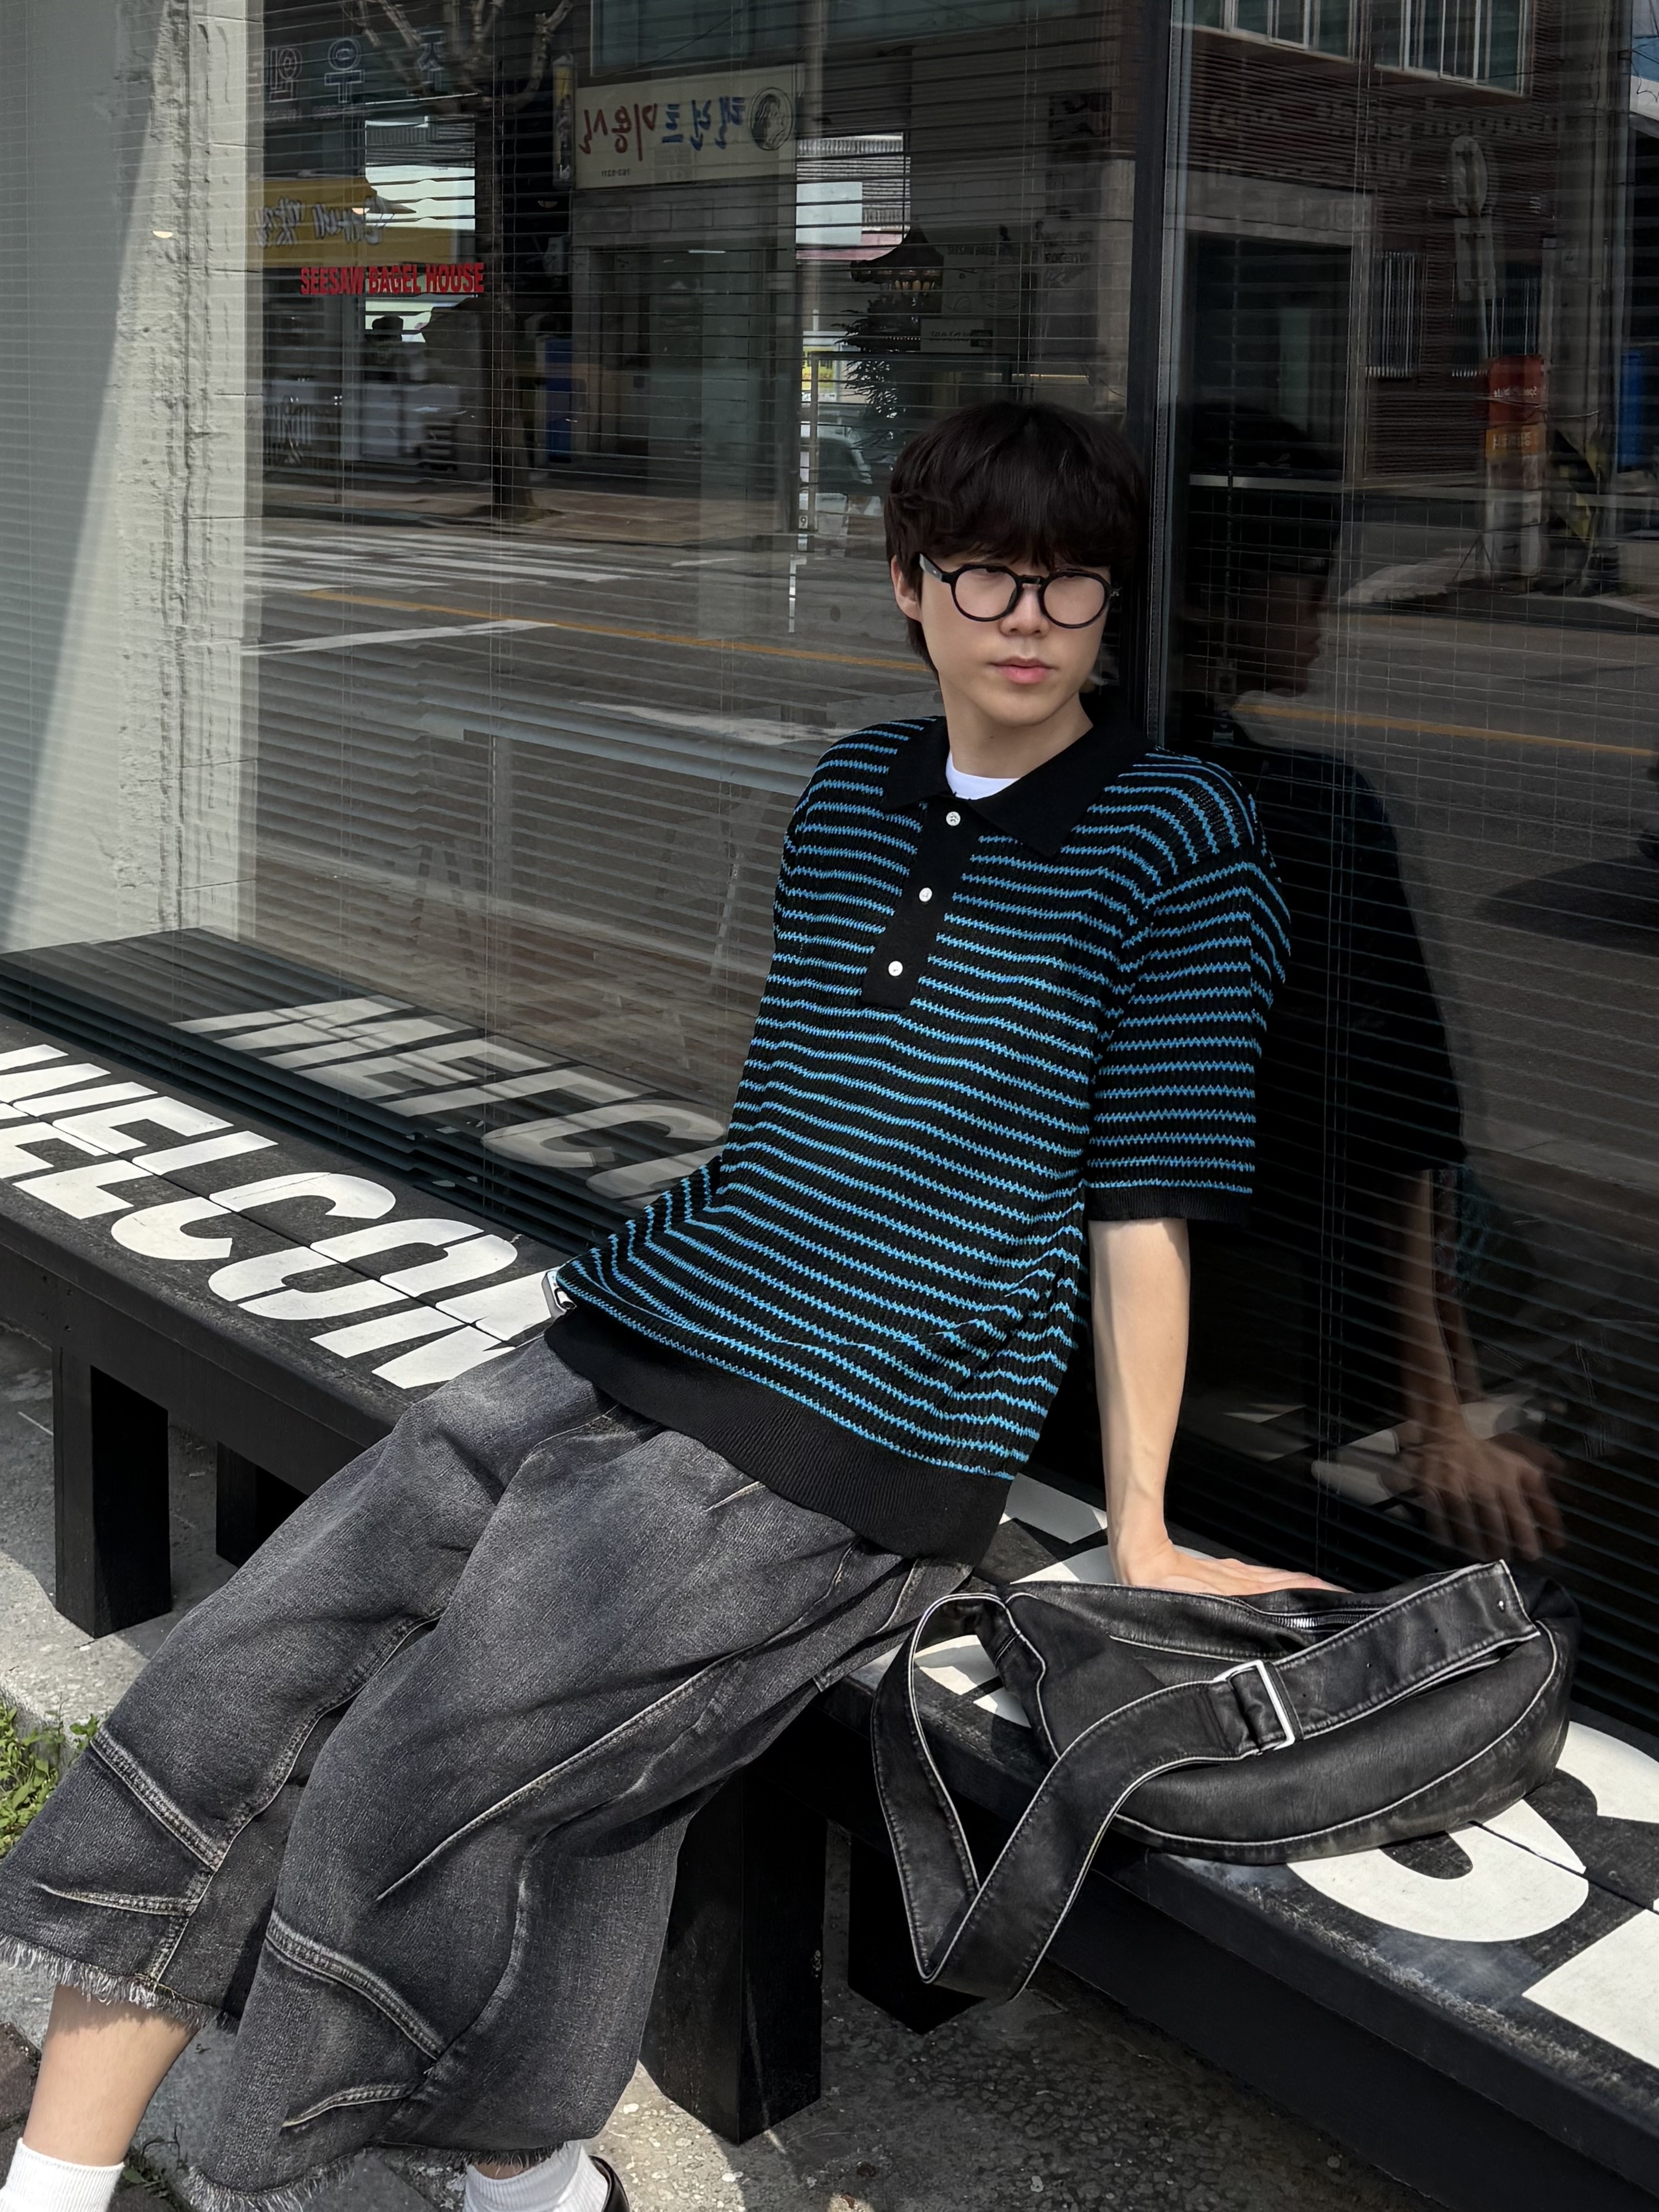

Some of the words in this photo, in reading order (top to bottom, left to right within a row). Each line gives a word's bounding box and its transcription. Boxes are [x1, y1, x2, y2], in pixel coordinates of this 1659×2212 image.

[301, 266, 365, 295] SEESAW
[367, 264, 421, 293] BAGEL
[425, 263, 484, 292] HOUSE
